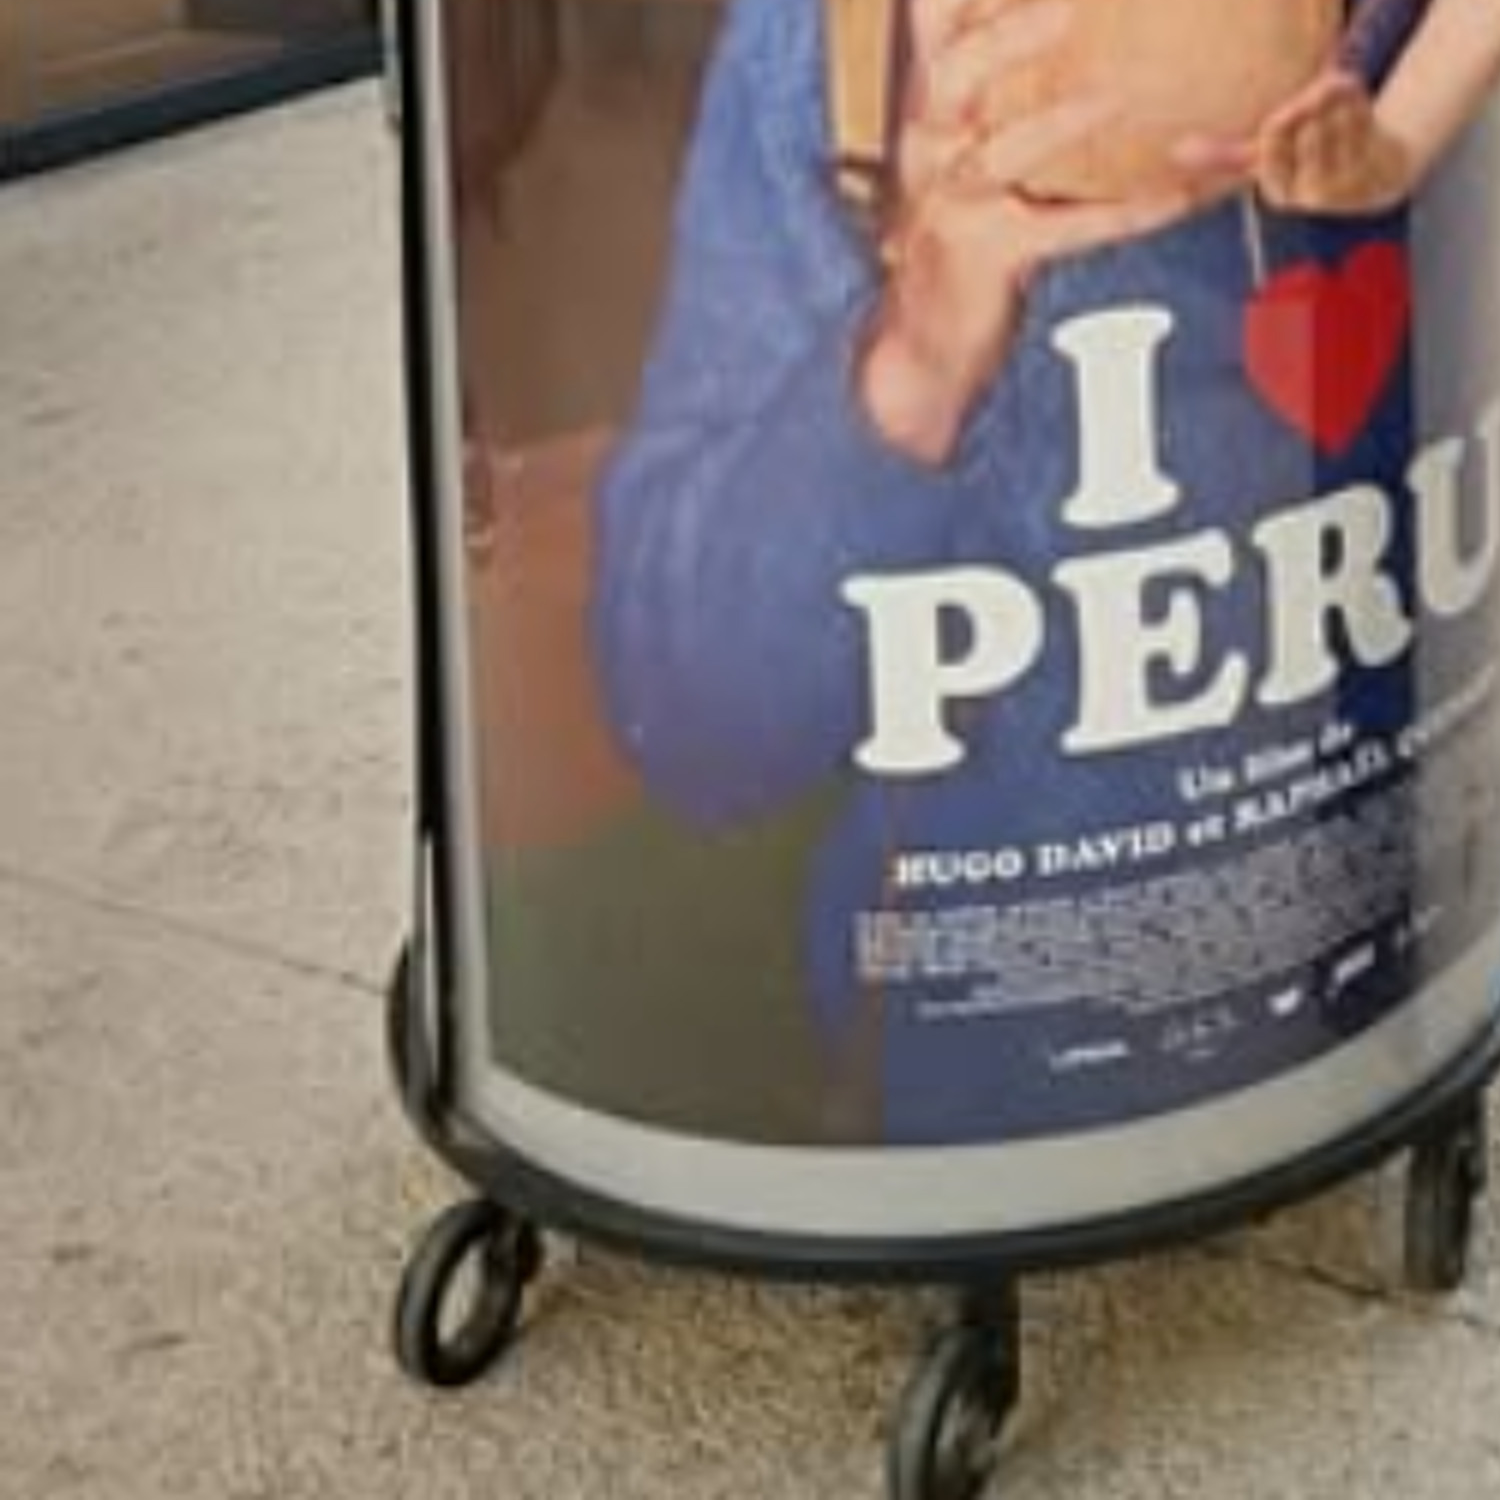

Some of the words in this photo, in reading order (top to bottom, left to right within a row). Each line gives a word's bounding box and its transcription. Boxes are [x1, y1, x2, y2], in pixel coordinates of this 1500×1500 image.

[1052, 306, 1180, 527] I
[897, 850, 1022, 886] HUGO
[1036, 820, 1176, 877] DAVID
